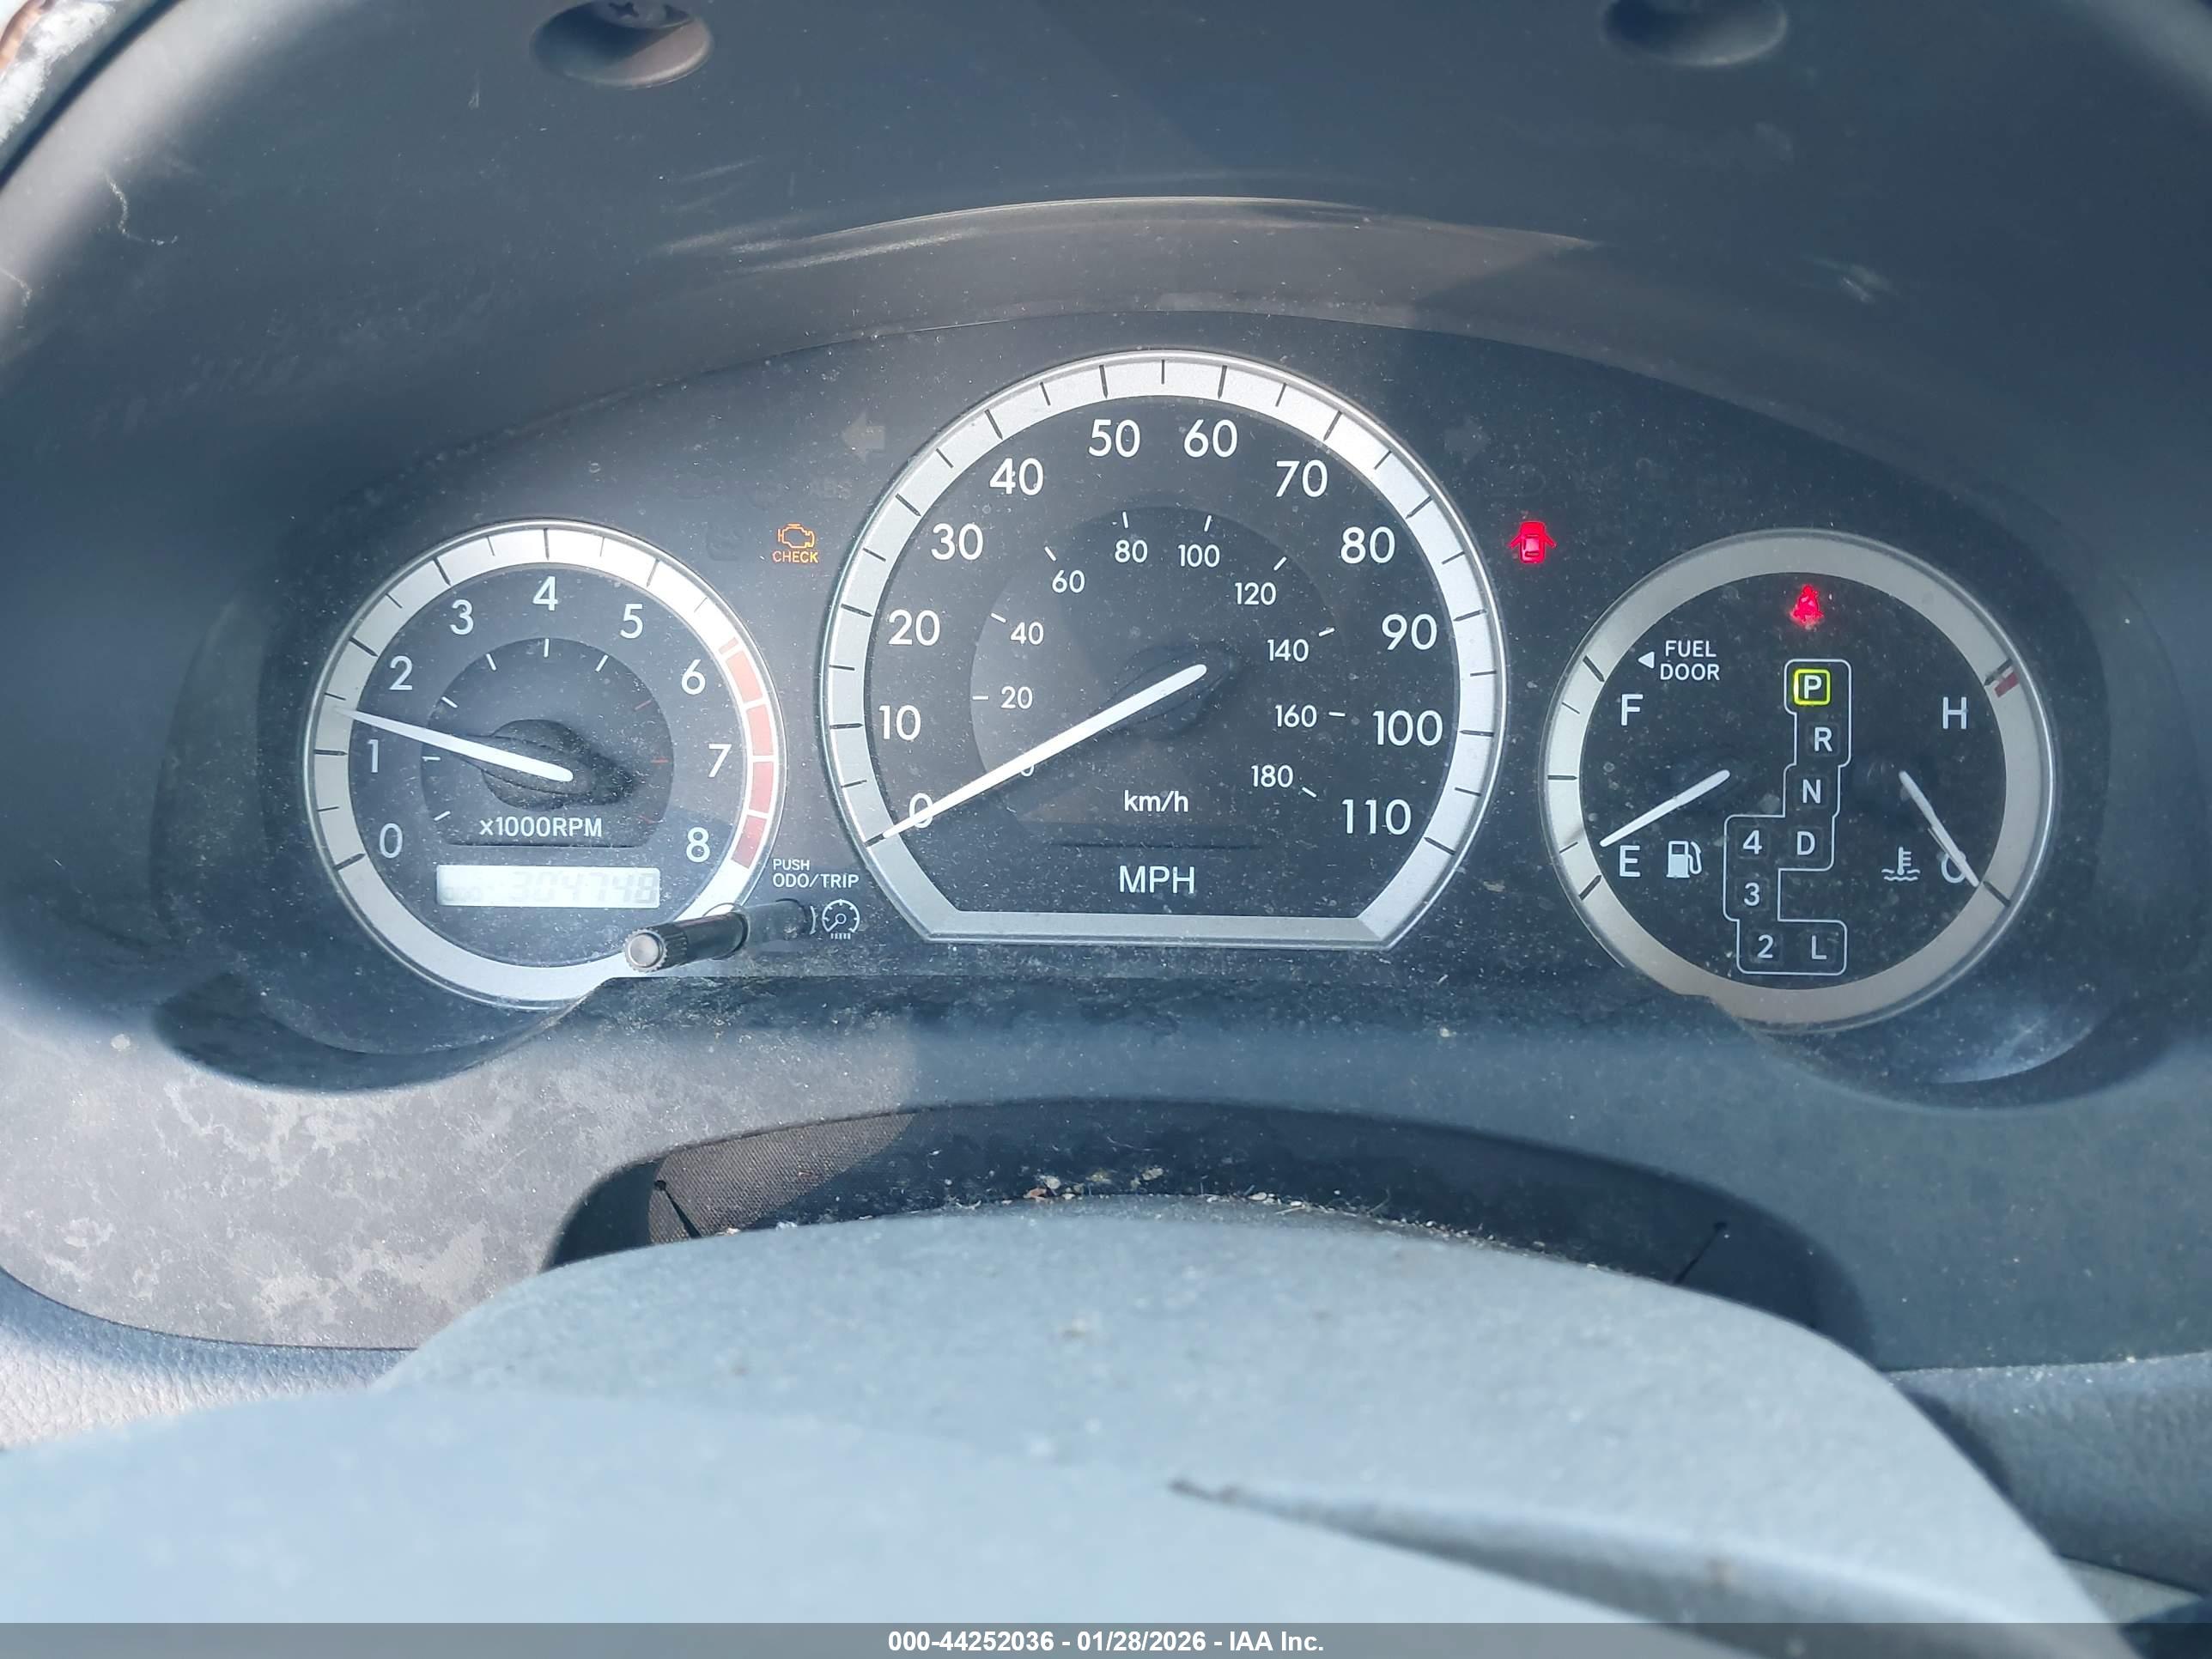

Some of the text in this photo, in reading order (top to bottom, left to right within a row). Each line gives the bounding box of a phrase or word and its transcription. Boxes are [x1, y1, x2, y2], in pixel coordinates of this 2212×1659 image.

[1089, 419, 1139, 457] 50
[1184, 420, 1237, 457] 60
[990, 459, 1043, 495] 40
[1277, 460, 1327, 497] 70
[932, 522, 983, 560] 30
[1115, 540, 1147, 562] 80
[1178, 544, 1219, 567] 100
[1341, 527, 1395, 563] 80
[773, 551, 817, 562] CHECK
[533, 576, 558, 611] 4
[1053, 570, 1085, 592] 60
[1235, 582, 1276, 605] 120
[450, 599, 473, 635] 3
[621, 604, 642, 638] 5
[886, 610, 939, 646] 20
[1382, 614, 1437, 650] 90
[1011, 622, 1043, 644] 40
[1267, 639, 1309, 661] 140
[1666, 641, 1717, 657] FUEL
[390, 656, 412, 690] 2
[682, 659, 705, 695] 6
[1661, 664, 1719, 680] DOOR
[1001, 686, 1032, 708] 20
[1802, 676, 1822, 699] P
[879, 705, 921, 742] 10
[1275, 704, 1316, 727] 160
[1621, 694, 1643, 726] F
[1943, 697, 1966, 729] H
[1373, 710, 1443, 745] 100
[1814, 727, 1832, 751] R
[368, 739, 378, 772] 1
[709, 744, 732, 777] 7
[1252, 765, 1293, 787] 180
[1125, 790, 1188, 811] km/h
[1803, 780, 1820, 803] N
[908, 793, 933, 829] 0
[1342, 799, 1411, 835] 110
[380, 823, 402, 858] 0
[479, 817, 601, 837] x1000RPM
[1743, 830, 1762, 854] 4
[686, 827, 710, 862] 8
[1797, 831, 1814, 854] D
[774, 858, 810, 870] PUSH
[1620, 845, 1640, 877] E
[509, 871, 657, 903] 304748
[773, 873, 859, 888] ODO/TRIP
[1120, 866, 1194, 894] MPH
[1744, 883, 1759, 906] 3
[1758, 934, 1773, 958] 2
[1812, 935, 1826, 959] L
